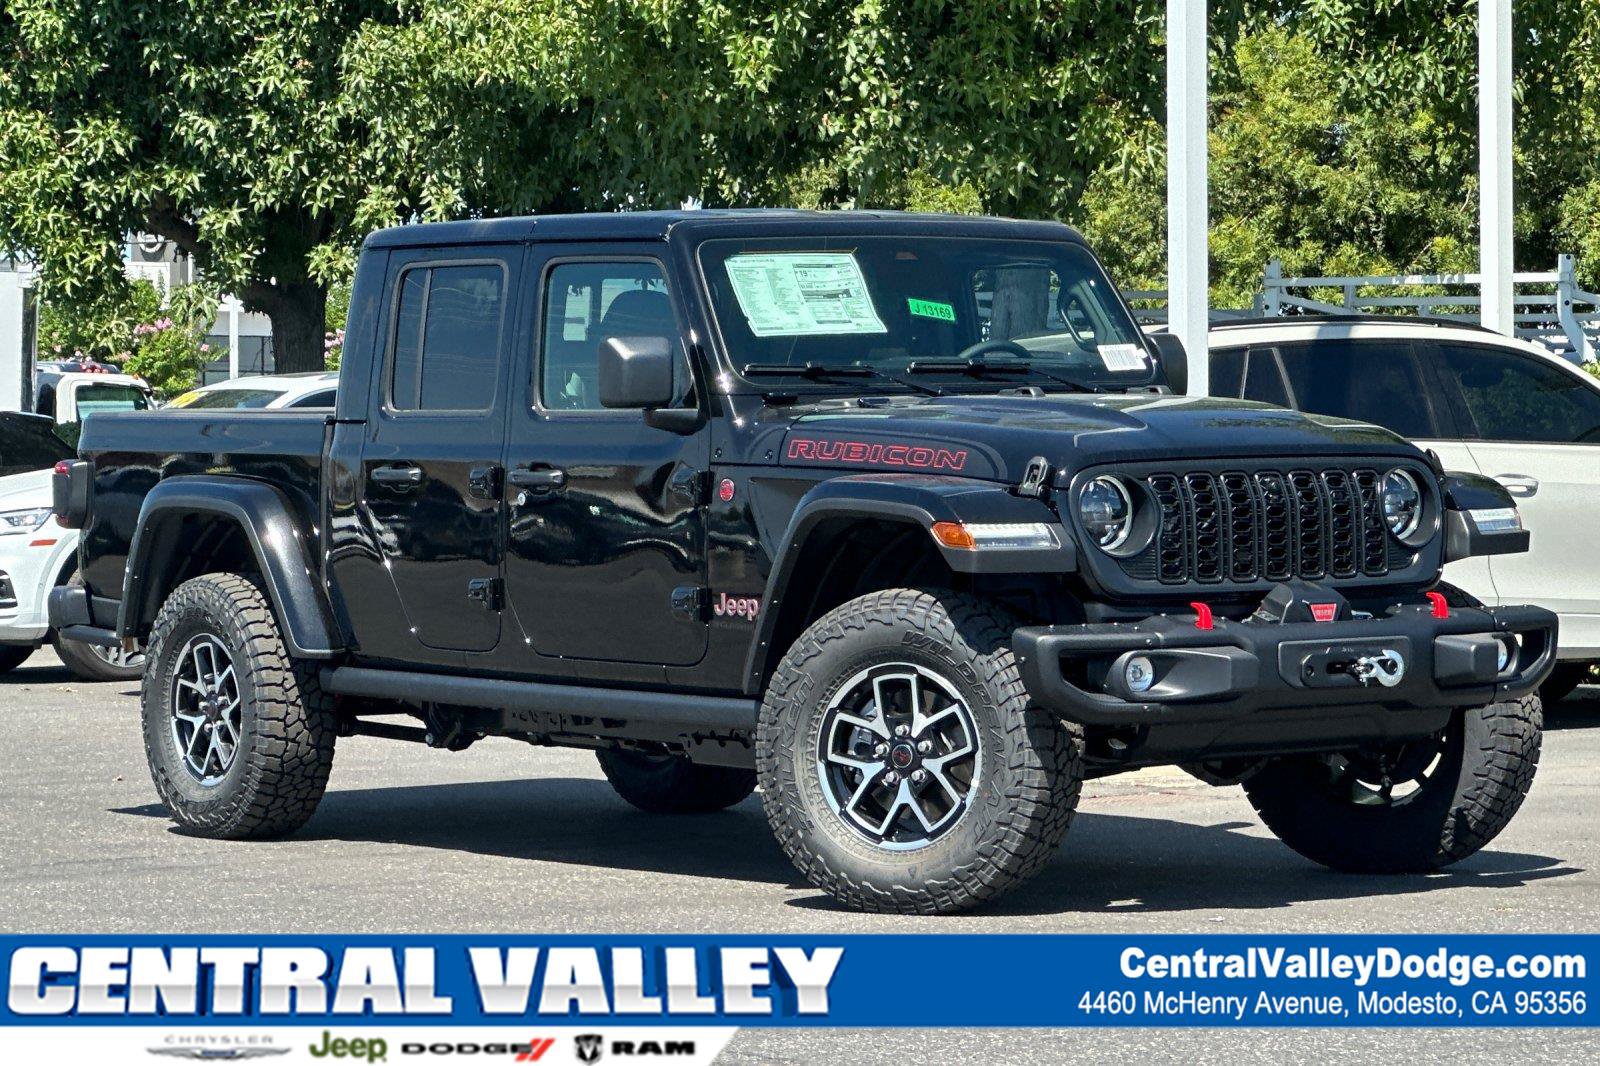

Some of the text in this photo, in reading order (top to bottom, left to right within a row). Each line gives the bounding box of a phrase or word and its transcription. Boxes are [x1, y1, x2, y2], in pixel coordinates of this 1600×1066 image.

[915, 303, 952, 319] J 13169
[787, 439, 967, 471] RUBICON
[714, 592, 759, 621] Jeep
